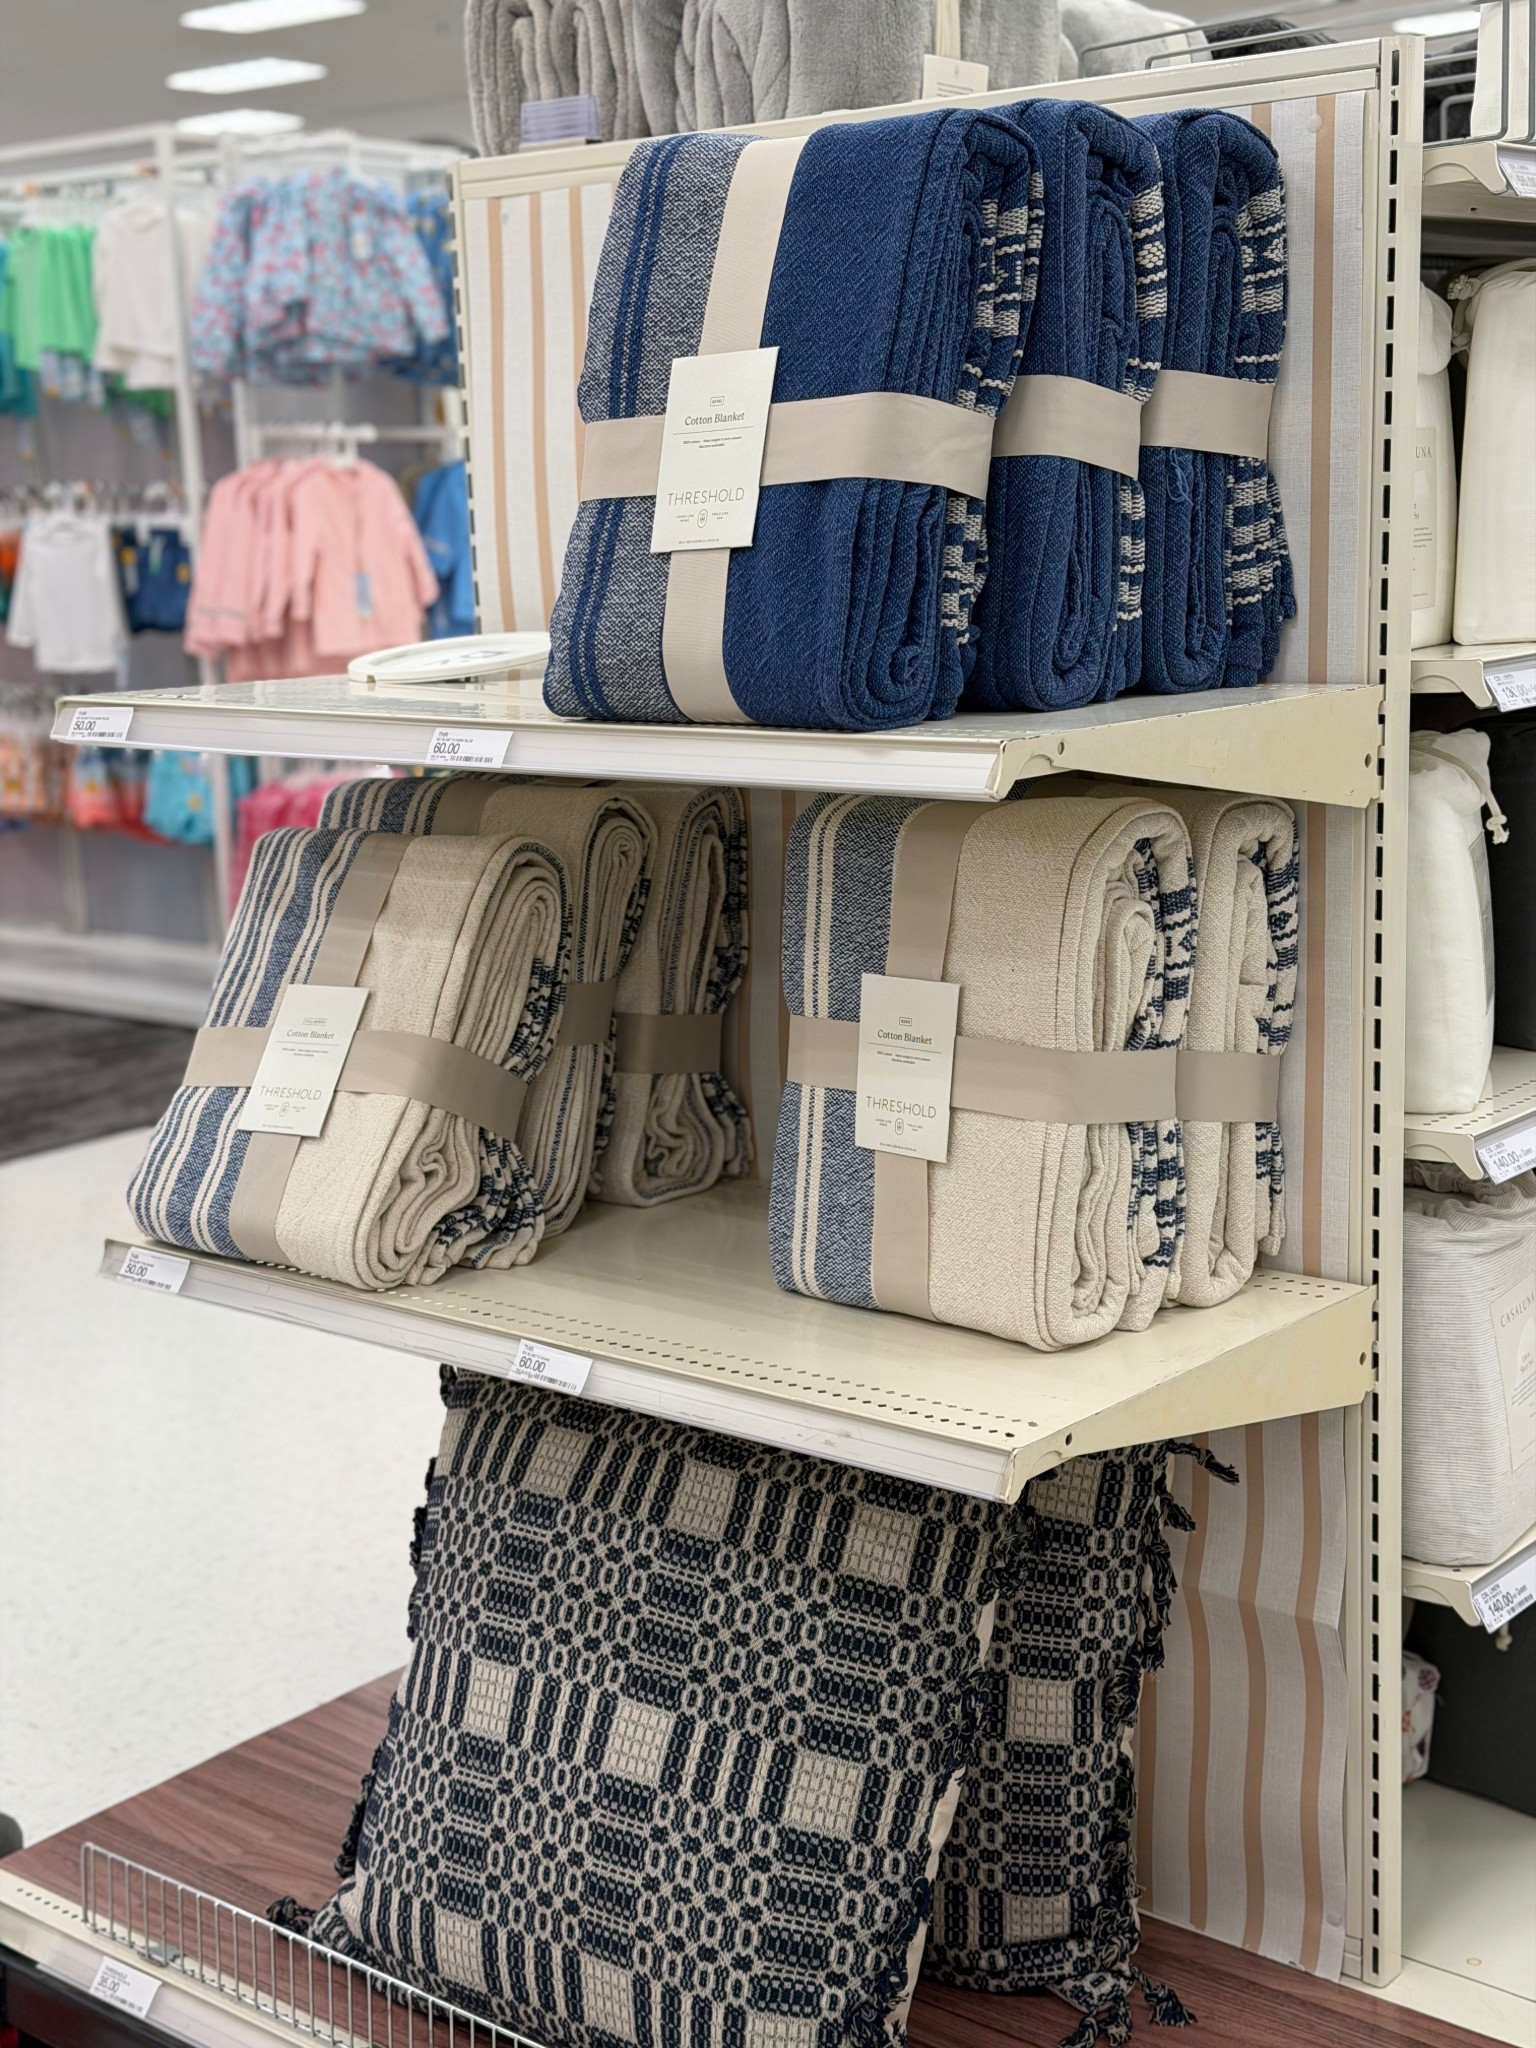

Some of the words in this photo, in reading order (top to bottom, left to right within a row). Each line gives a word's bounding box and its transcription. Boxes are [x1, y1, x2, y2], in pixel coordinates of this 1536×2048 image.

[685, 415, 712, 426] Cotton
[714, 412, 744, 424] Blanket
[667, 487, 745, 506] THRESHOLD
[73, 720, 97, 731] 50.00
[433, 742, 460, 755] 60.00
[286, 1029, 309, 1039] Cotton
[309, 1030, 335, 1040] Blanket
[877, 1029, 902, 1041] Cotton
[904, 1033, 932, 1046] Blanket
[259, 1085, 322, 1101] THRESHOLD
[866, 1096, 937, 1119] THRESHOLD
[125, 1262, 148, 1277] 50.00
[519, 1355, 546, 1373] 60.00
[1488, 1591, 1514, 1617] 140.00
